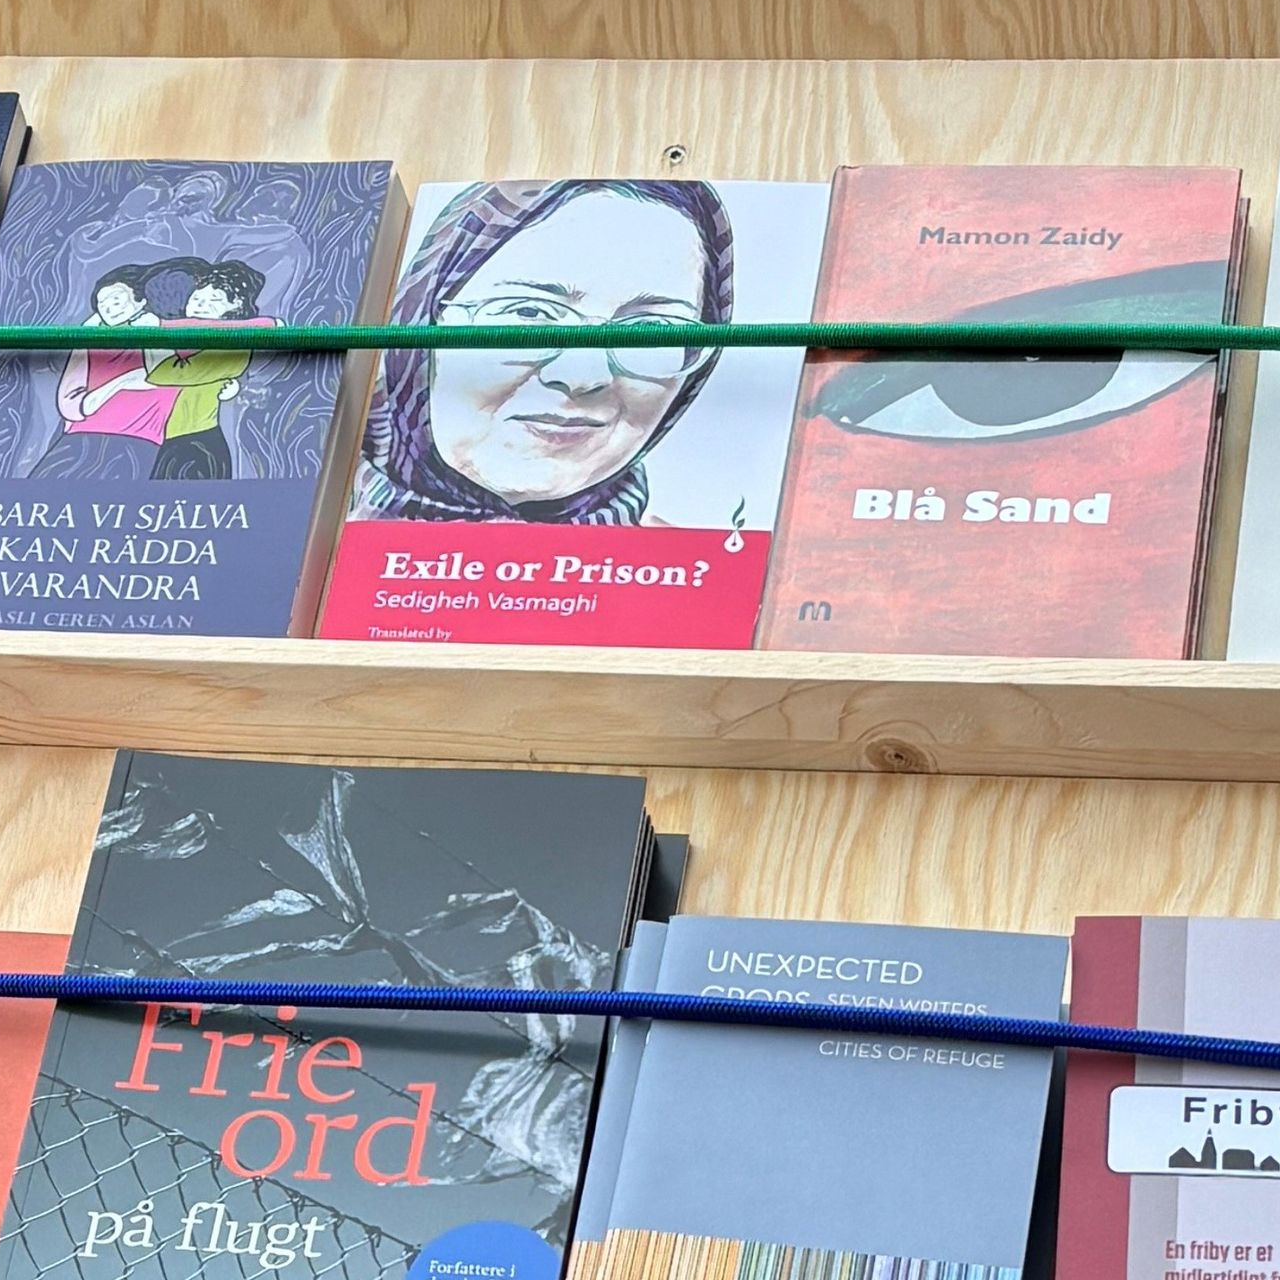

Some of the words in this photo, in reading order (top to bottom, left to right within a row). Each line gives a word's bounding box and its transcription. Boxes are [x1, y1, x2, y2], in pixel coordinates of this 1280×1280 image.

[918, 227, 1030, 247] Mamon
[1039, 227, 1124, 252] Zaidy
[91, 502, 126, 529] VI
[135, 500, 250, 530] SJÄLVA
[852, 487, 946, 521] Blå
[962, 490, 1112, 525] Sand
[89, 534, 218, 566] RÄDDA
[380, 551, 484, 582] Exile
[495, 561, 539, 583] or
[549, 554, 711, 588] Prison?
[0, 571, 202, 602] VARANDRA
[373, 590, 480, 613] Sedigheh
[487, 592, 598, 616] Vasmaghi
[43, 612, 116, 629] CEREN
[120, 613, 194, 630] ASLAN
[368, 625, 433, 640] Translated
[435, 627, 452, 642] by
[706, 949, 924, 985] UNEXPECTED
[827, 993, 894, 1011] SEVEN
[114, 1002, 363, 1104] Frie
[819, 1040, 882, 1060] CITIES
[888, 1045, 918, 1061] OF
[923, 1047, 1006, 1070] REFUGE
[220, 1082, 438, 1186] ord
[78, 1198, 155, 1259] på
[174, 1201, 326, 1268] flugt
[1165, 1239, 1185, 1260] En
[1190, 1240, 1230, 1263] friby
[1234, 1245, 1252, 1262] er
[1256, 1244, 1274, 1262] et
[429, 1260, 506, 1277] Forfattere
